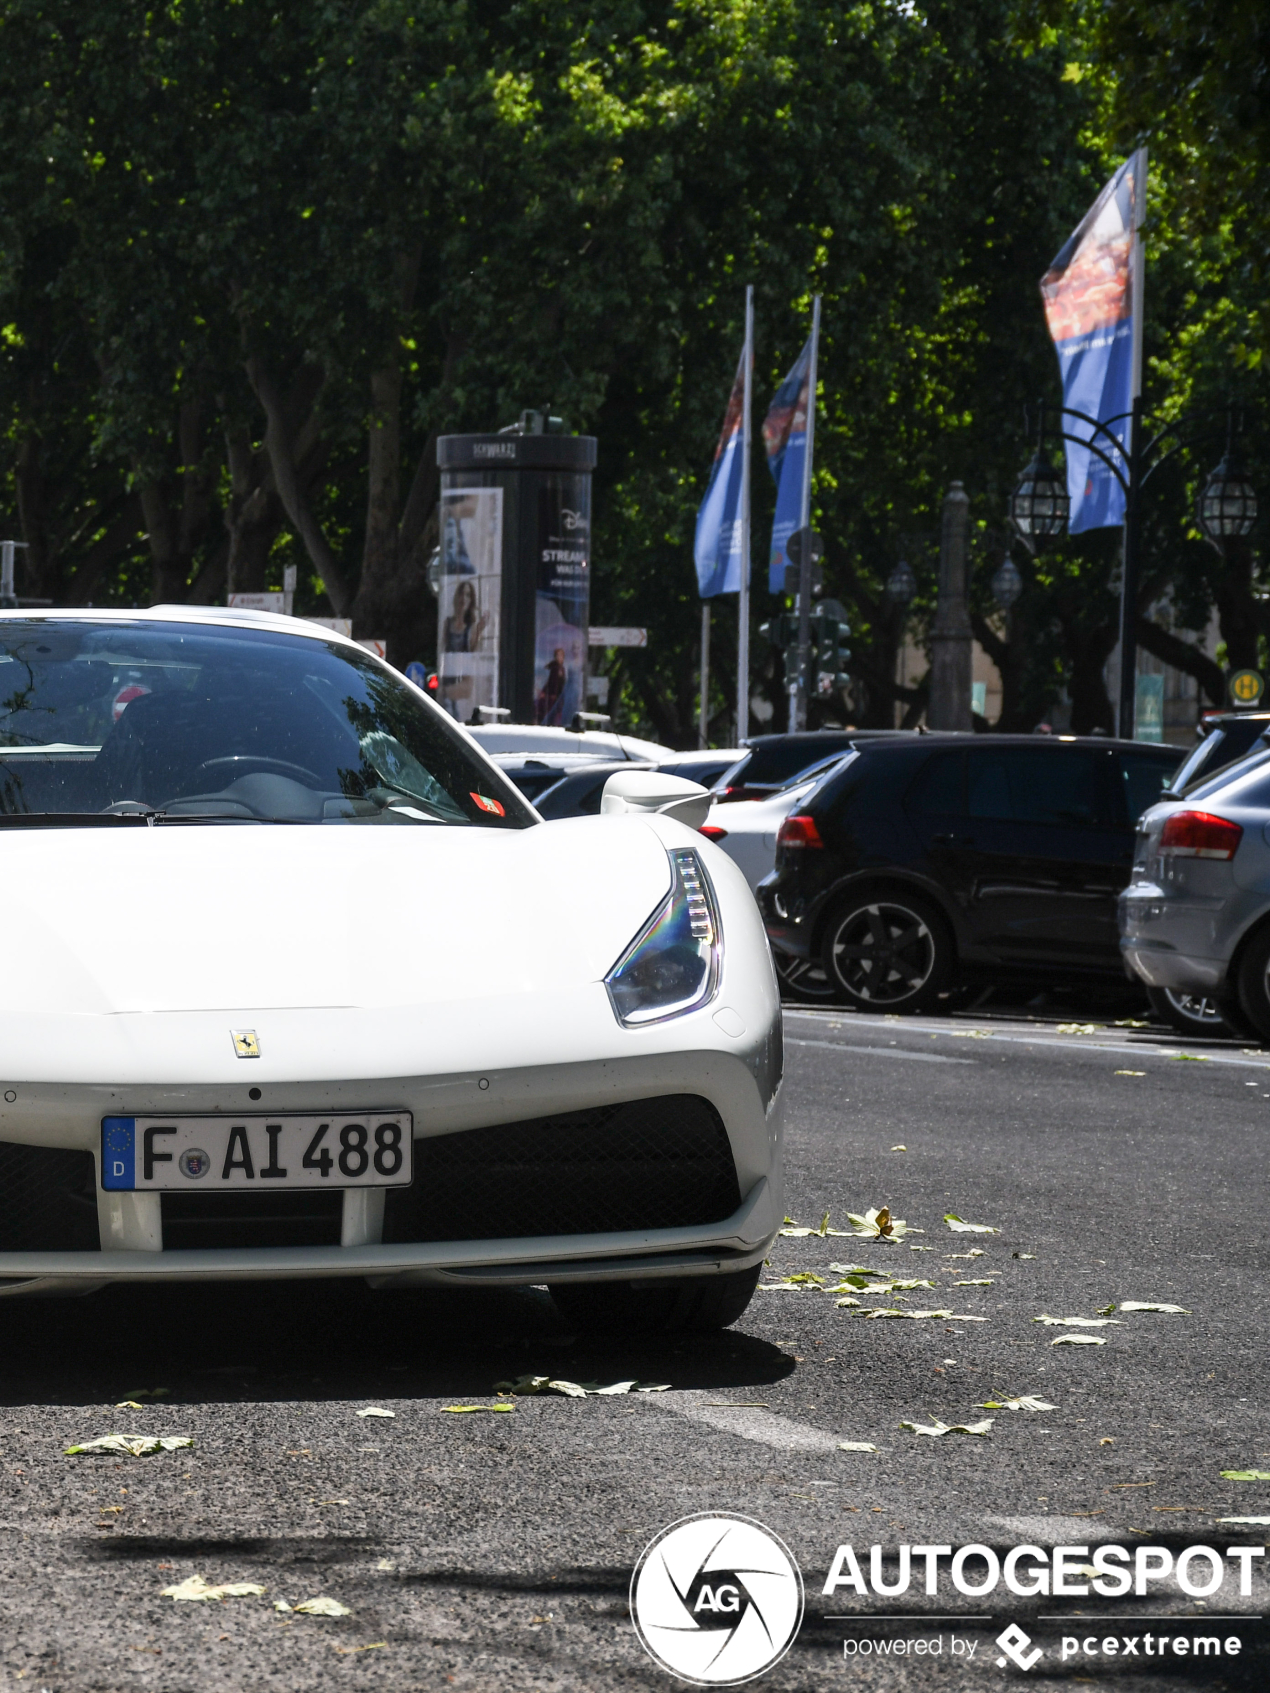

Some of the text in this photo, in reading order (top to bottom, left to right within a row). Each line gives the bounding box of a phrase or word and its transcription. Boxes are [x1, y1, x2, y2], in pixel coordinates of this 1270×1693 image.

[1241, 679, 1254, 695] H
[143, 1123, 403, 1180] F AI 488
[113, 1161, 125, 1177] D
